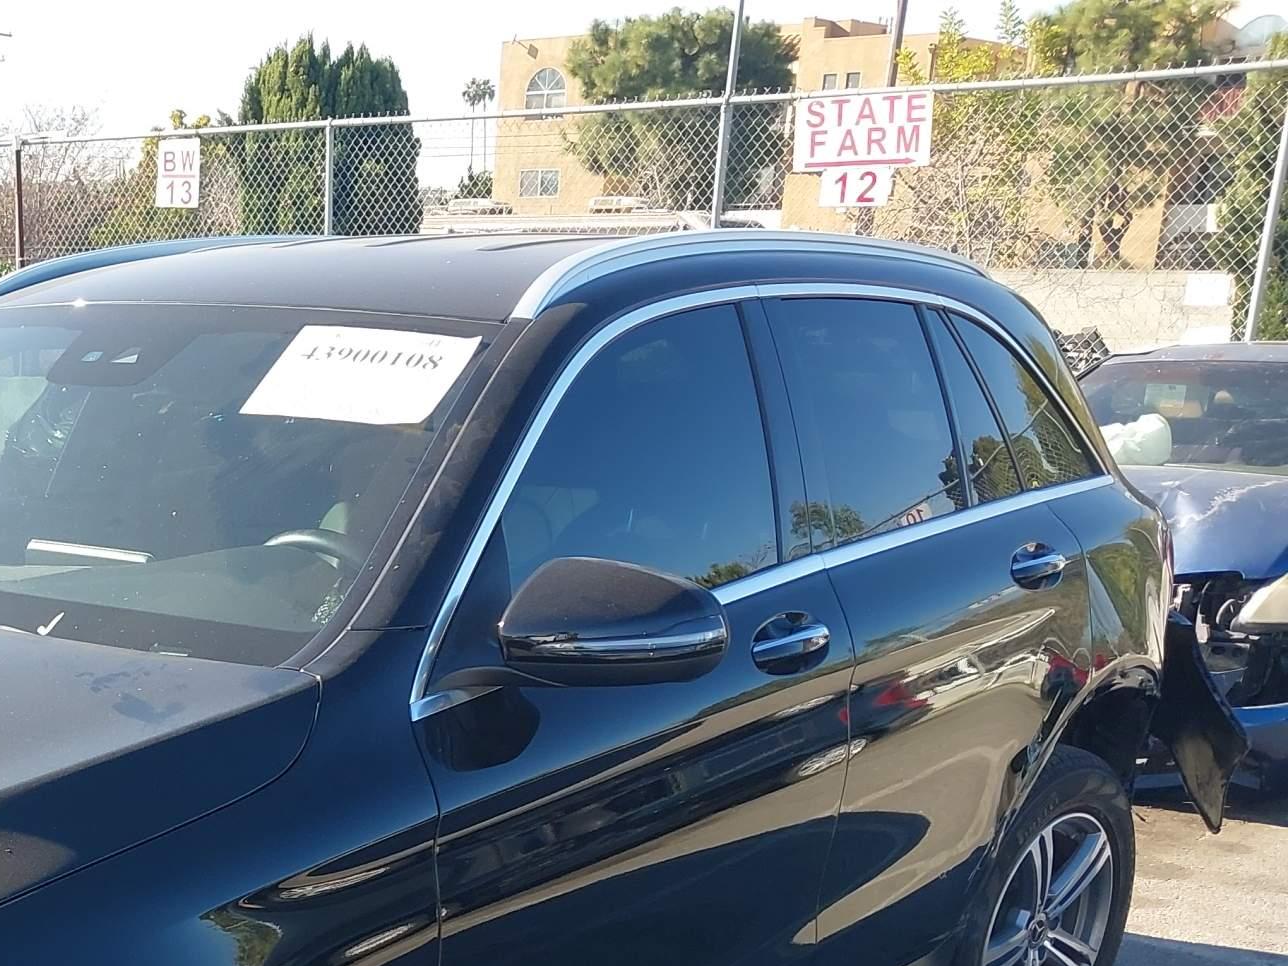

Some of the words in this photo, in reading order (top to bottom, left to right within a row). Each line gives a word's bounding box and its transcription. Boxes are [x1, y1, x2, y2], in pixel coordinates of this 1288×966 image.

[806, 93, 927, 128] STATE
[809, 125, 921, 158] FARM
[163, 150, 195, 172] BW
[166, 180, 192, 205] 13
[834, 171, 878, 203] 12
[300, 345, 444, 371] 43900108
